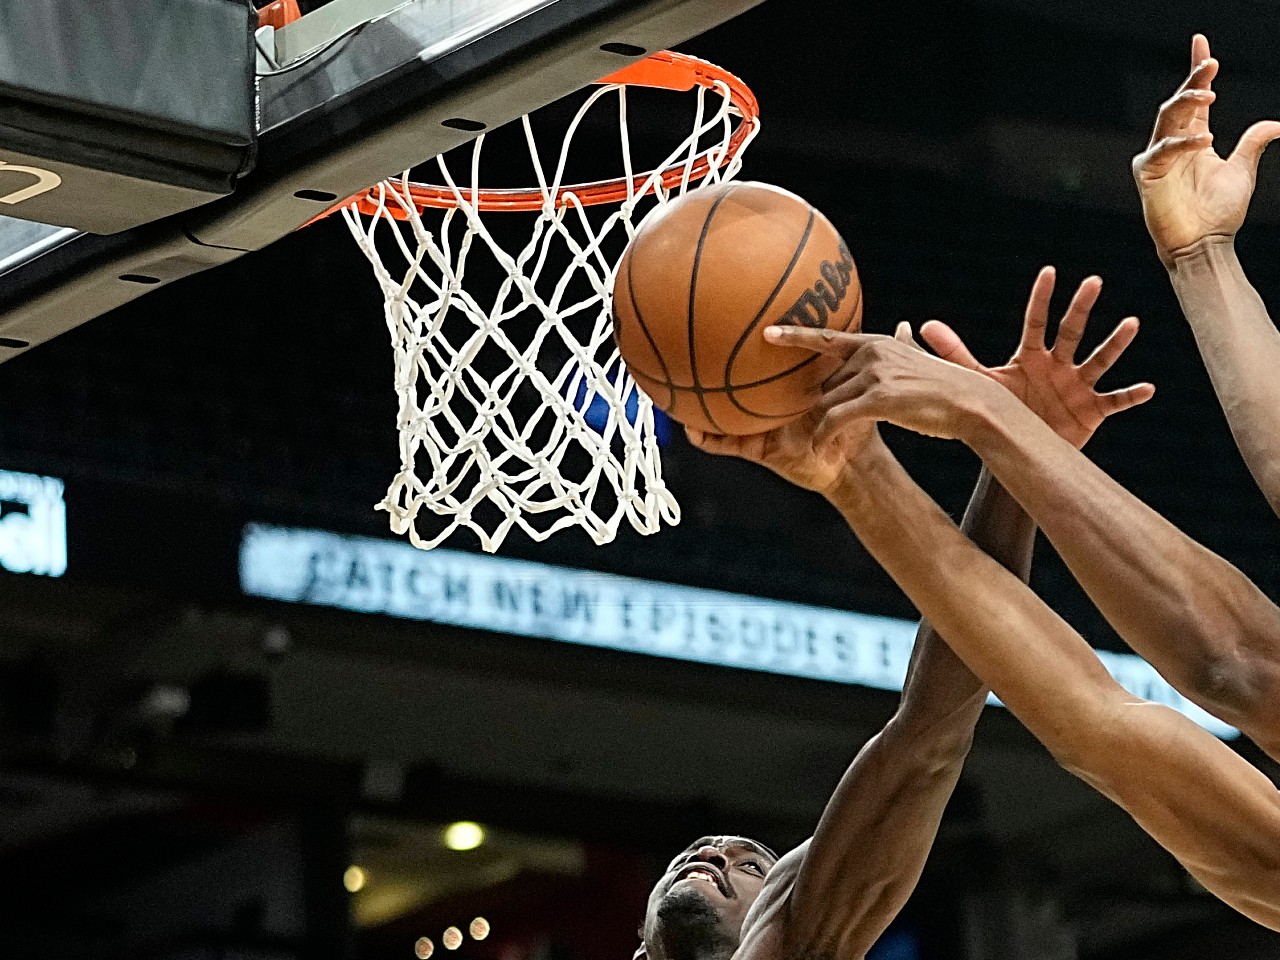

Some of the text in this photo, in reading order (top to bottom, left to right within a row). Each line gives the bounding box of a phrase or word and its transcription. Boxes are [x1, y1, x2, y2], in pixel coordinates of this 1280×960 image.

[308, 552, 472, 600] CATCH
[492, 577, 594, 623] NEW
[621, 597, 850, 662] EPISODES
